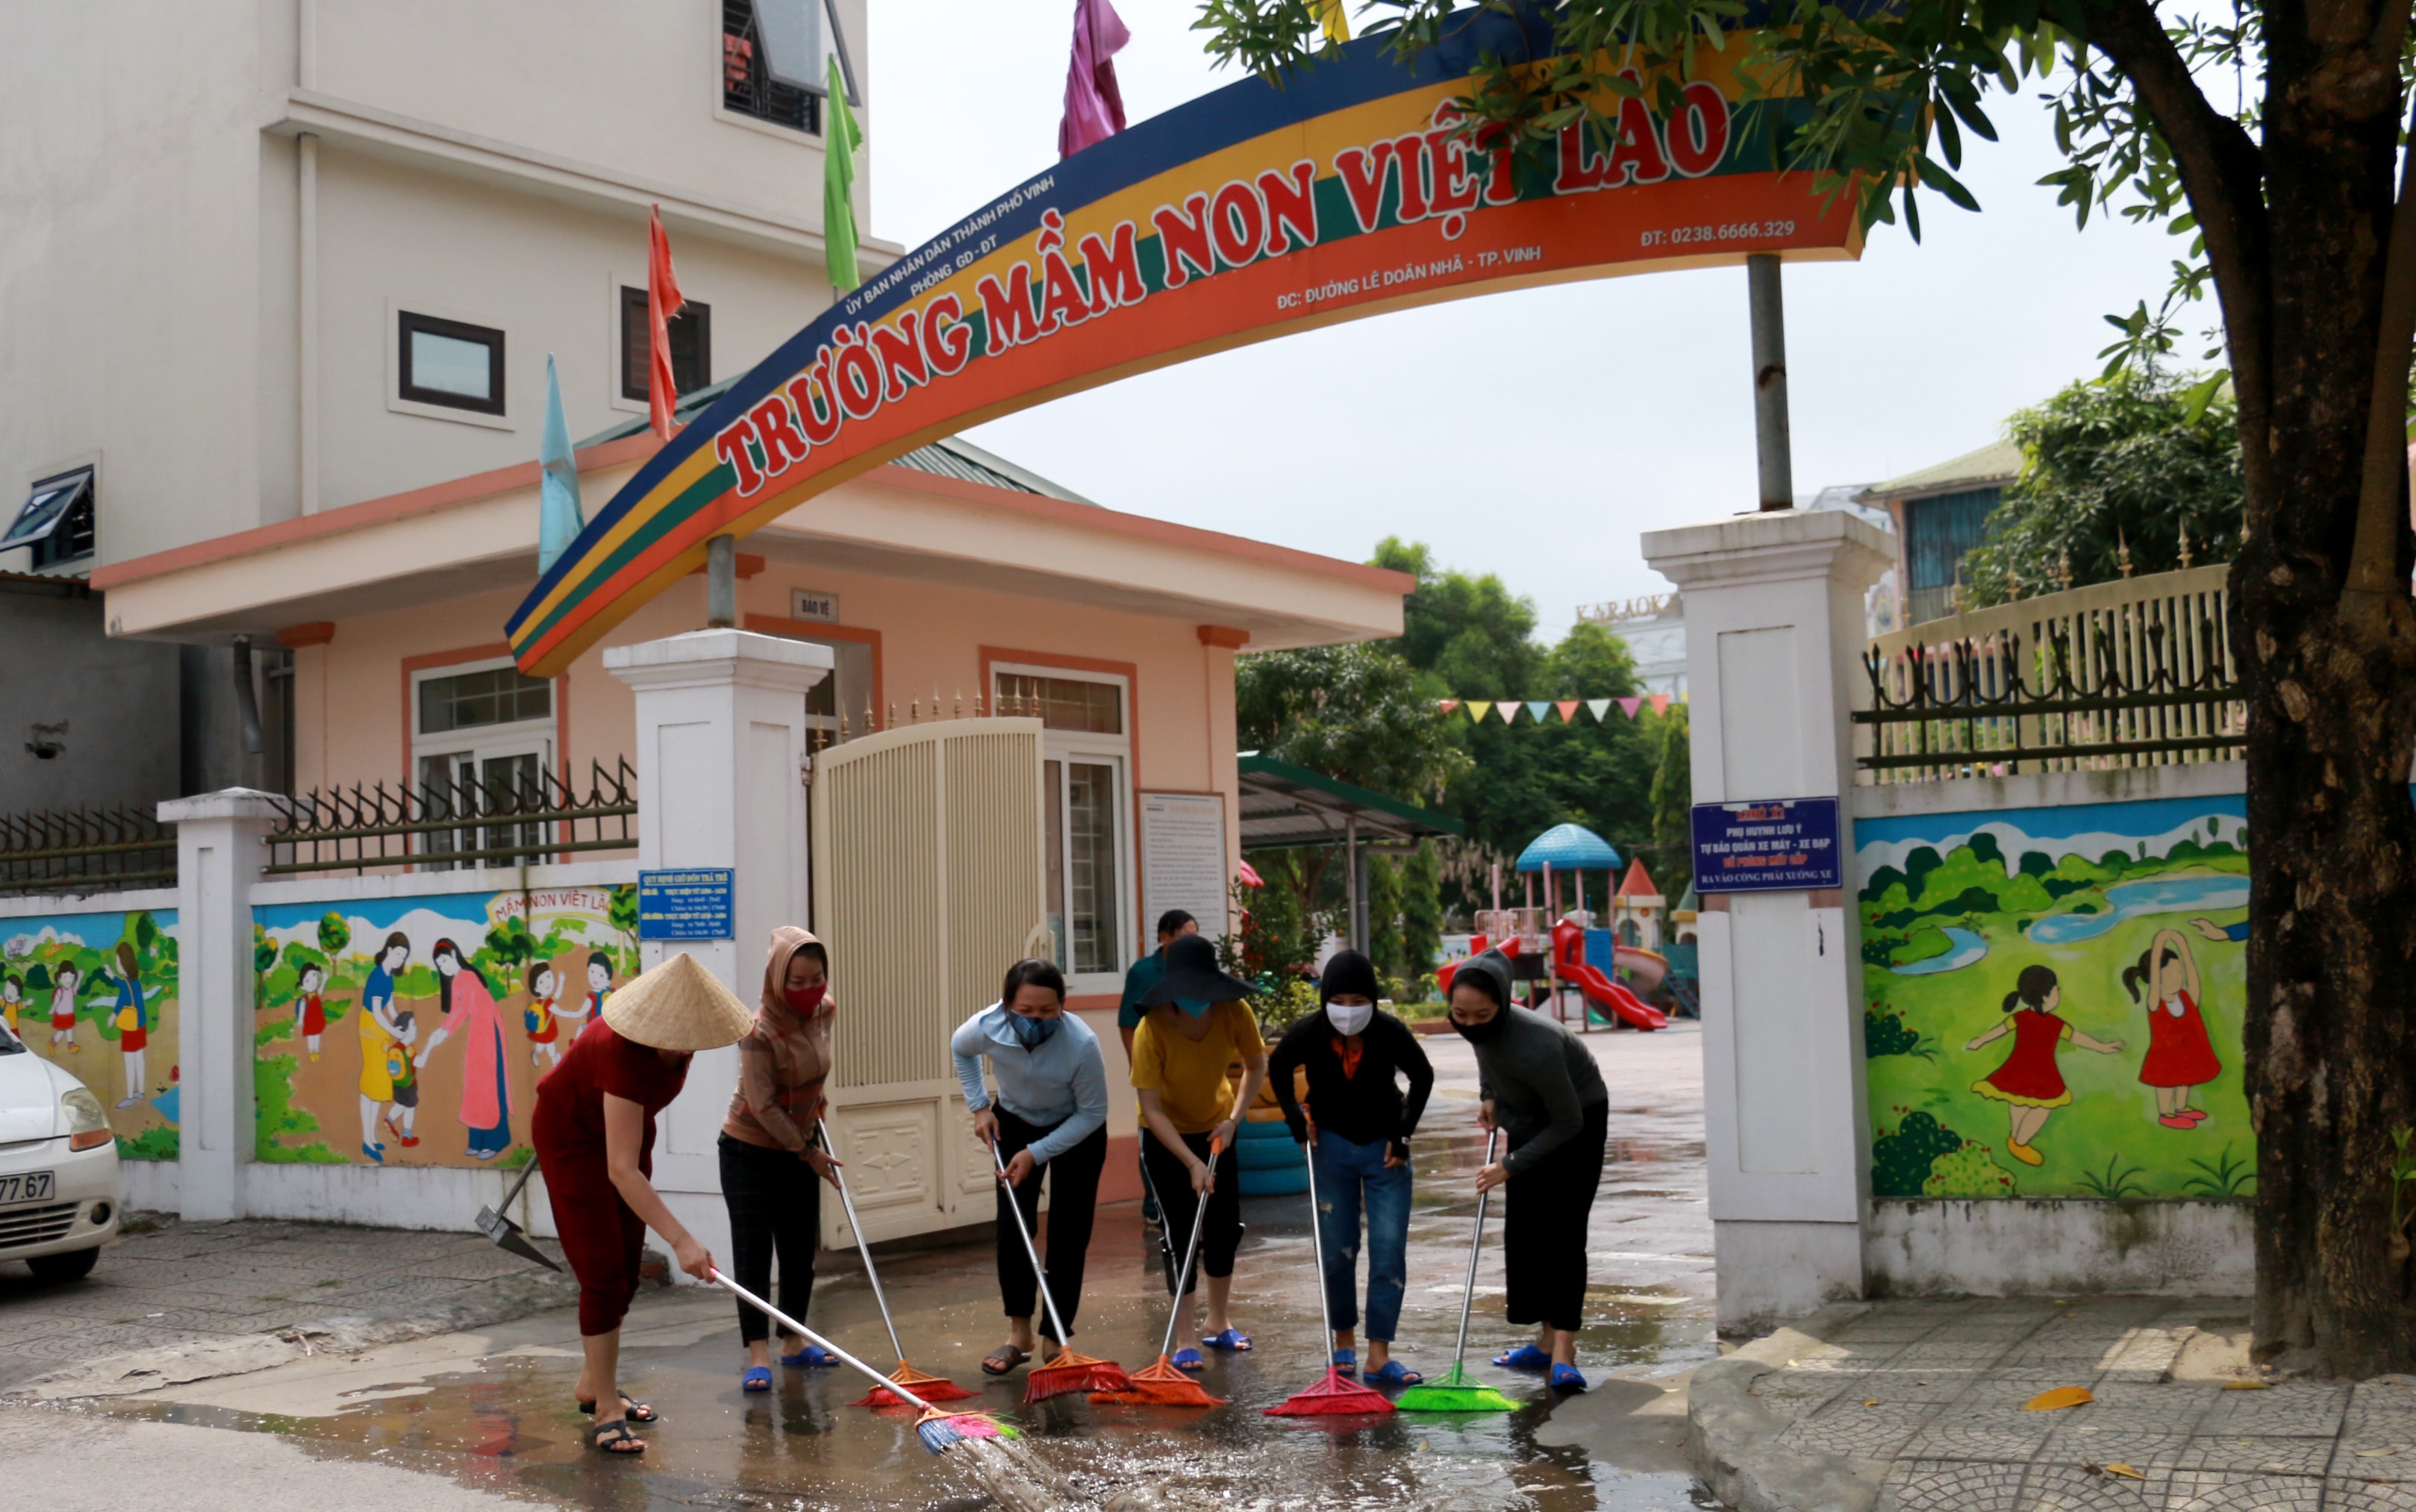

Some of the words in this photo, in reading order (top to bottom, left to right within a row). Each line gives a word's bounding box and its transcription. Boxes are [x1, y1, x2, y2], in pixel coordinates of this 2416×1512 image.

[846, 296, 862, 315] ỦY
[864, 278, 890, 304] BAN
[889, 254, 925, 286] NHÂN
[925, 238, 952, 263] DÂN
[952, 210, 996, 243] THÀNH
[996, 189, 1023, 218] PHỐ
[1023, 175, 1055, 200] VINH
[1641, 229, 1668, 247] ĐT:
[1671, 220, 1795, 244] 0238.6666.329
[910, 264, 952, 297] PHÒNG
[955, 251, 974, 268] GD
[980, 234, 997, 254] ĐT
[1277, 293, 1302, 310] ĐC:
[1305, 279, 1359, 304] ĐƯỜNG
[1362, 270, 1380, 290] LÊ
[1383, 263, 1426, 287] DOÃN
[1430, 254, 1464, 276] NHÃ
[716, 291, 973, 498] TRƯỜNG
[976, 207, 1147, 357] MẦM
[1152, 158, 1319, 290] NON
[1333, 98, 1524, 241] VIỆT
[1576, 591, 1680, 625] KARAOKE
[1713, 840, 1730, 853] BẢO
[1732, 840, 1756, 854] QUẢN
[1757, 841, 1770, 852] XE
[1771, 838, 1791, 850] MÁY
[1799, 839, 1811, 850] XE
[1726, 827, 1744, 839] PHỤ
[1746, 825, 1775, 836] HUYNH
[1777, 824, 1795, 835] LƯU
[1820, 869, 1832, 879] XE
[528, 893, 556, 908] NON
